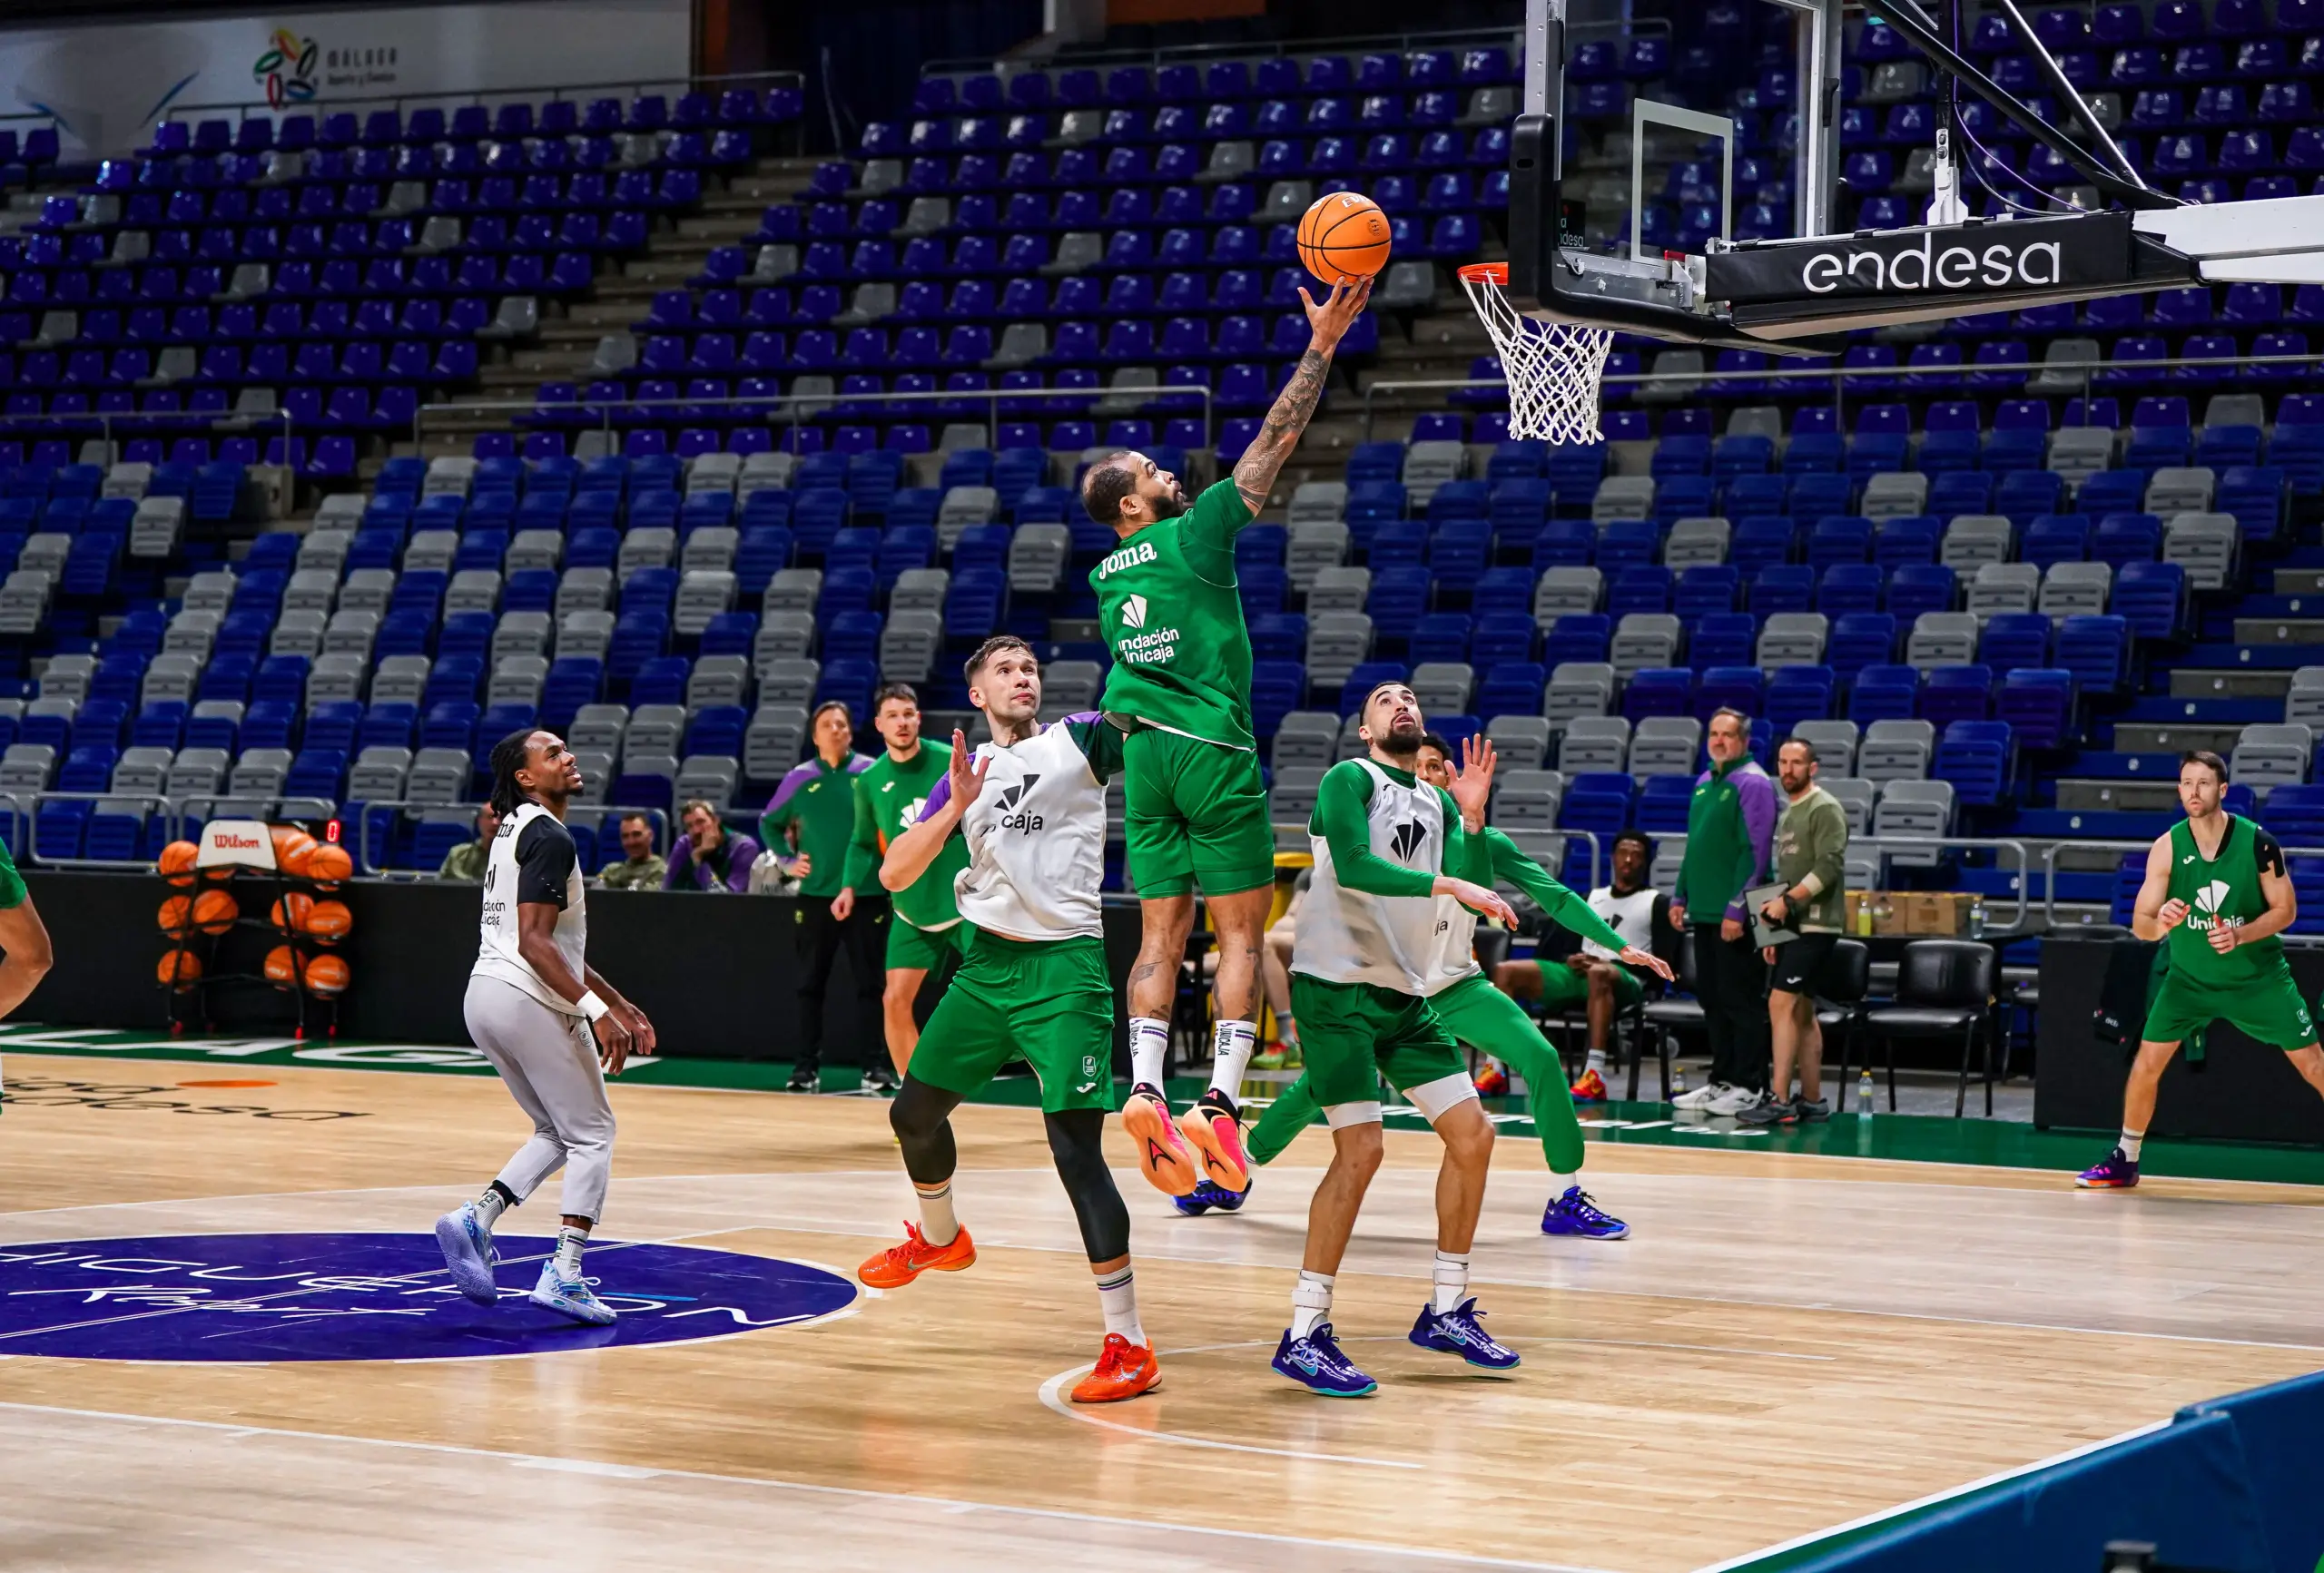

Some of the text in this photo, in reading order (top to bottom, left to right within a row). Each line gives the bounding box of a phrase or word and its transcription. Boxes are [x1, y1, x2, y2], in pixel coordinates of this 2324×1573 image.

[1560, 230, 1584, 247] desa
[1802, 231, 2061, 293] endesa
[1118, 627, 1180, 652] ndación
[327, 820, 340, 843] 0
[1000, 810, 1044, 837] caja
[213, 834, 261, 850] Wilson
[2187, 914, 2246, 931] Uniaja
[1217, 1027, 1234, 1057] UNICAJA
